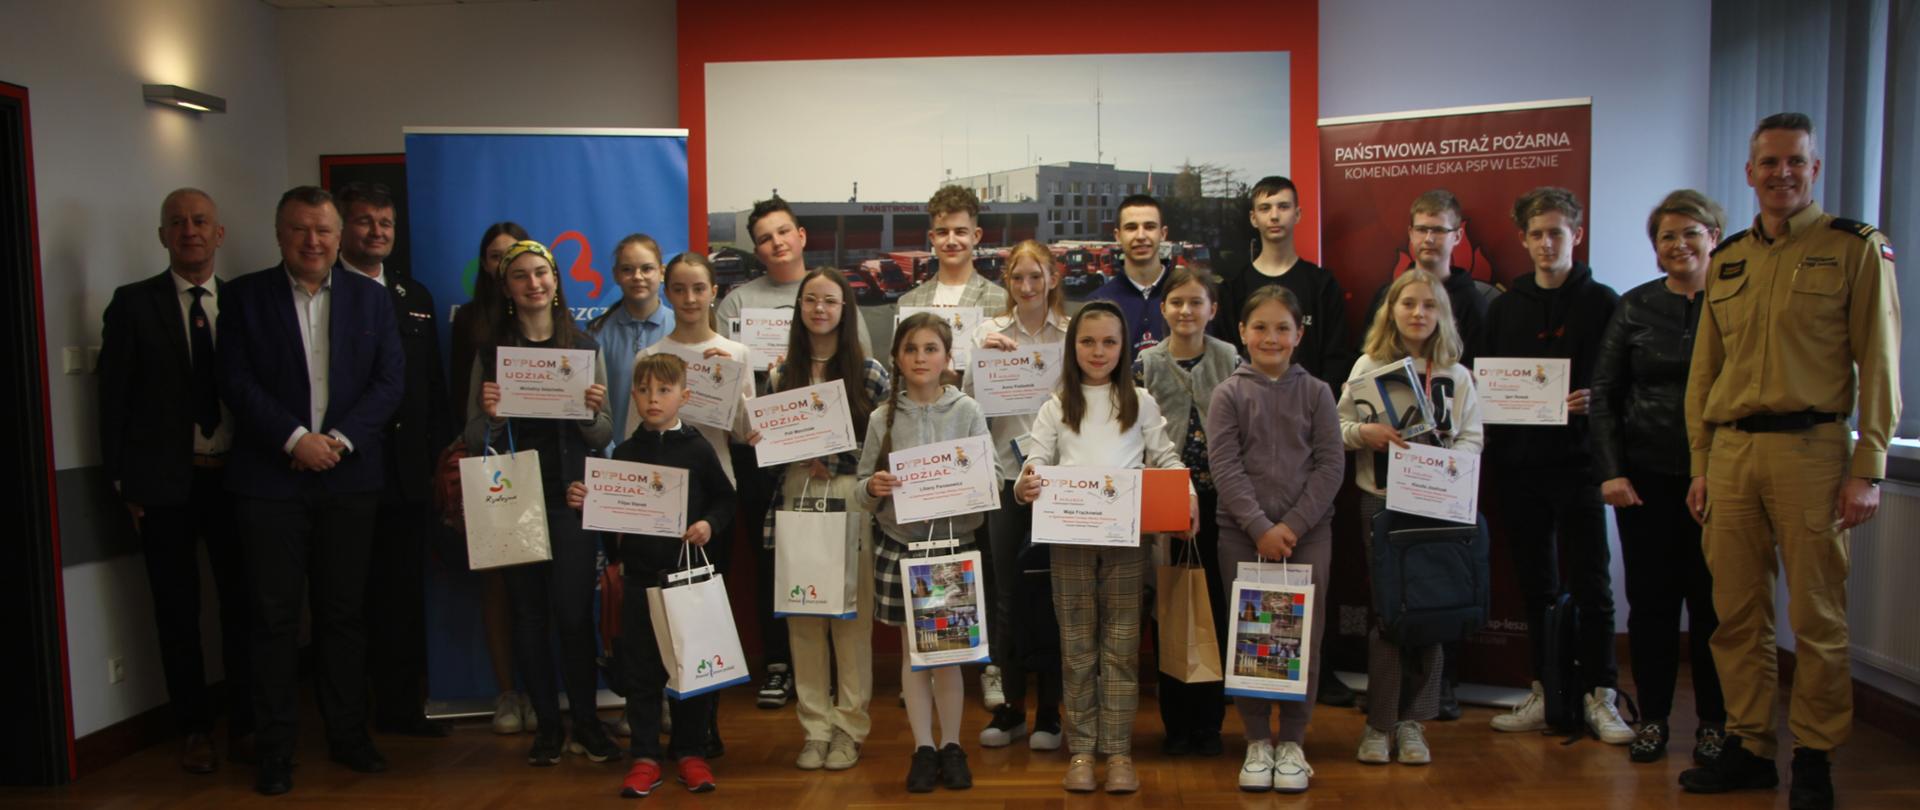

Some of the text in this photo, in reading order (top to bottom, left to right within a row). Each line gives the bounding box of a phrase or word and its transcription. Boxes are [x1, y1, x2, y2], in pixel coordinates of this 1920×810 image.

[1334, 131, 1570, 162] PAŃSTWOWA STRAŻ POŻARNA
[1344, 154, 1559, 180] KOMENDA MIEJSKA PSP W LESZNIE
[503, 358, 556, 368] DYPLOM
[978, 357, 1030, 368] DYPLOM
[1479, 369, 1532, 377] DYPLOM
[754, 399, 808, 418] DYPLOM
[760, 414, 808, 429] UDZIAŁ
[896, 453, 952, 471] DYPLOM
[1394, 452, 1444, 468] DYPLOM
[591, 470, 648, 483] DYPLOM
[1040, 478, 1099, 489] DYPLOM
